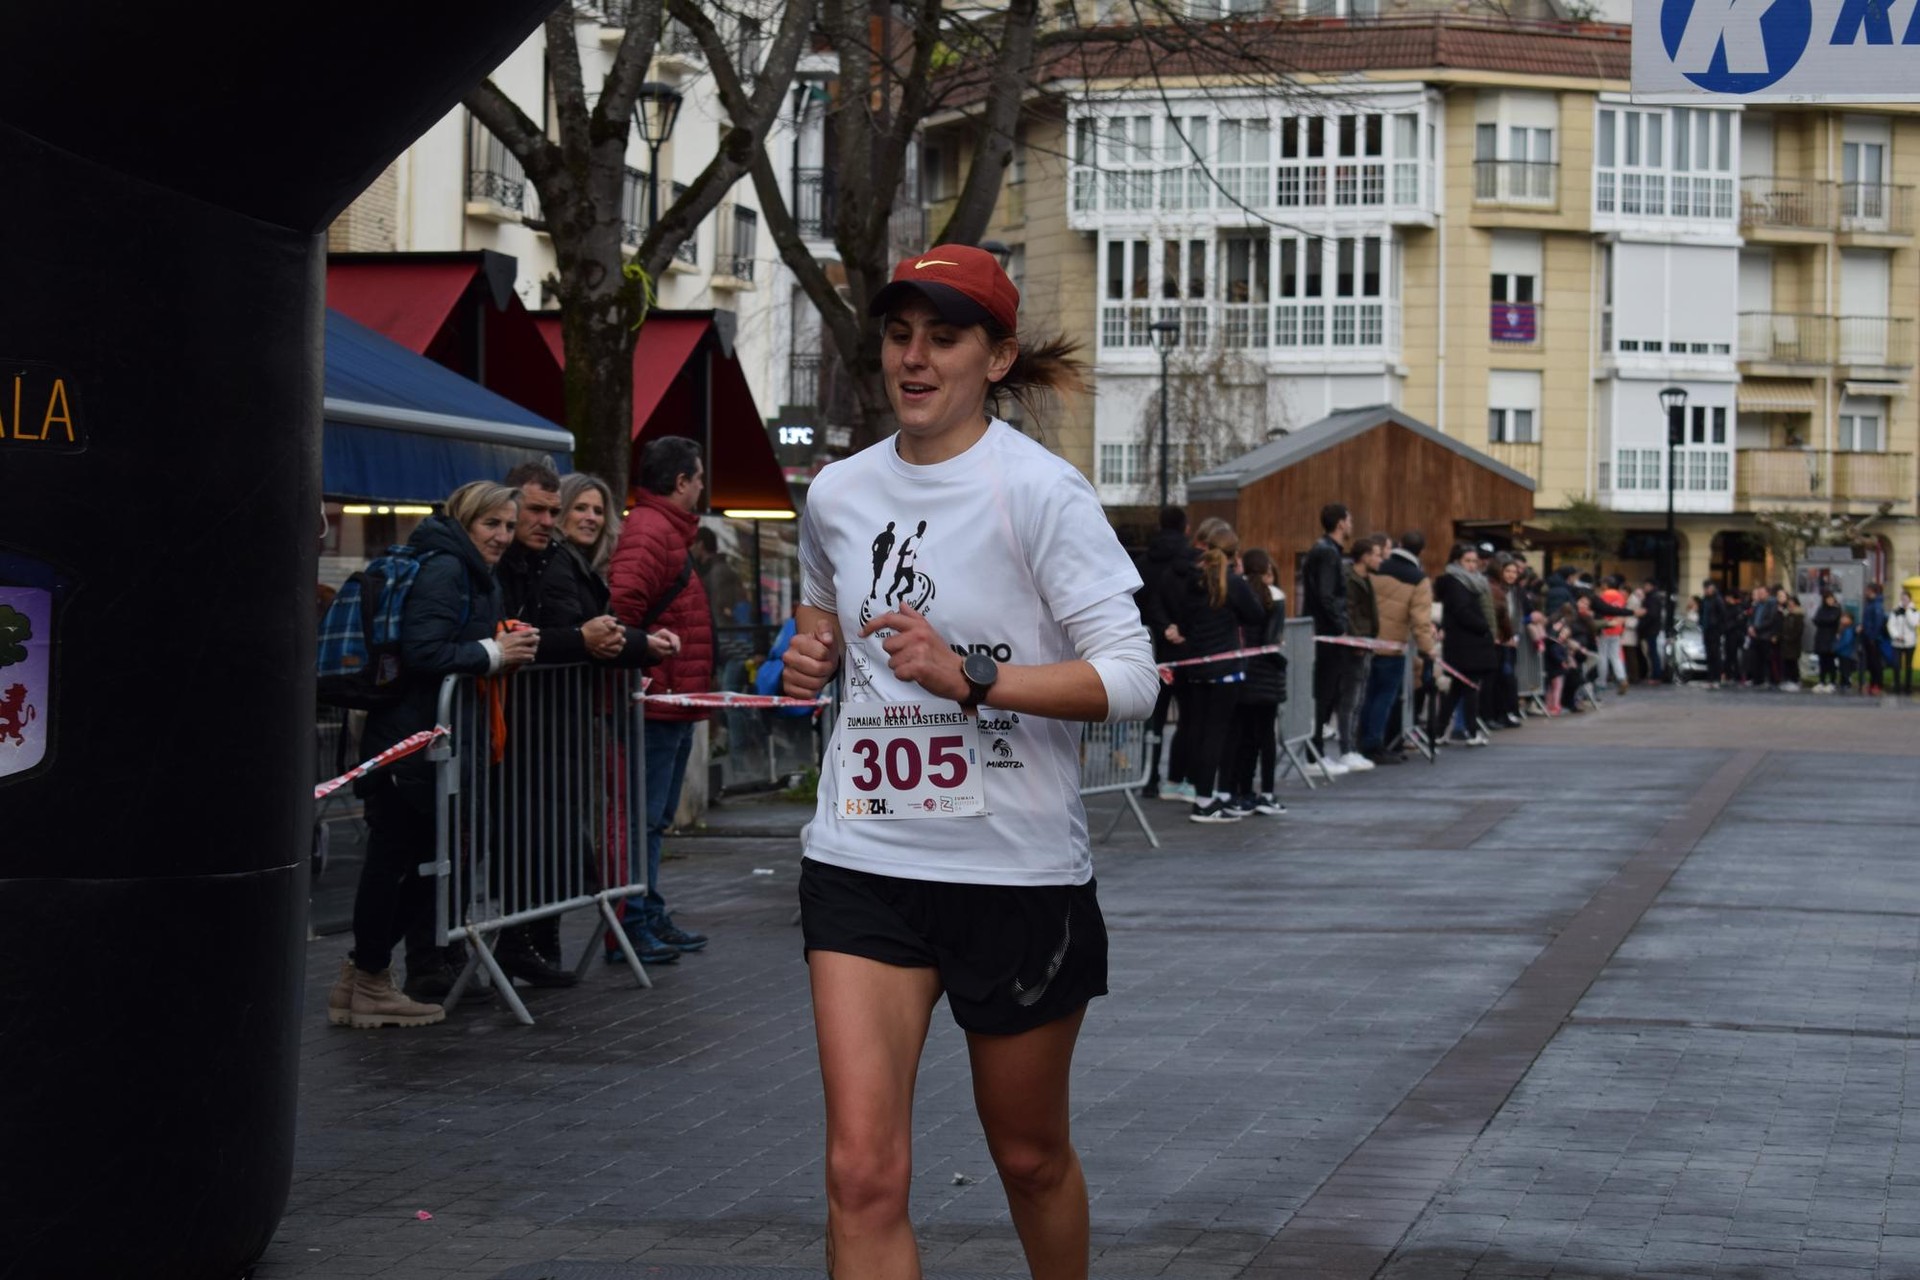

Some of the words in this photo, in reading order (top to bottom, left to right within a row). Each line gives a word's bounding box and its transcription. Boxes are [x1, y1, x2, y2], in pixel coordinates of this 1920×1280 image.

[0, 376, 75, 442] LA
[875, 630, 891, 638] San
[847, 717, 881, 727] ZUMAIAKO
[884, 716, 908, 726] HERRI
[911, 712, 969, 725] LASTERKETA
[884, 705, 921, 720] XXXIX
[978, 718, 1013, 731] zeta
[852, 735, 968, 791] 305
